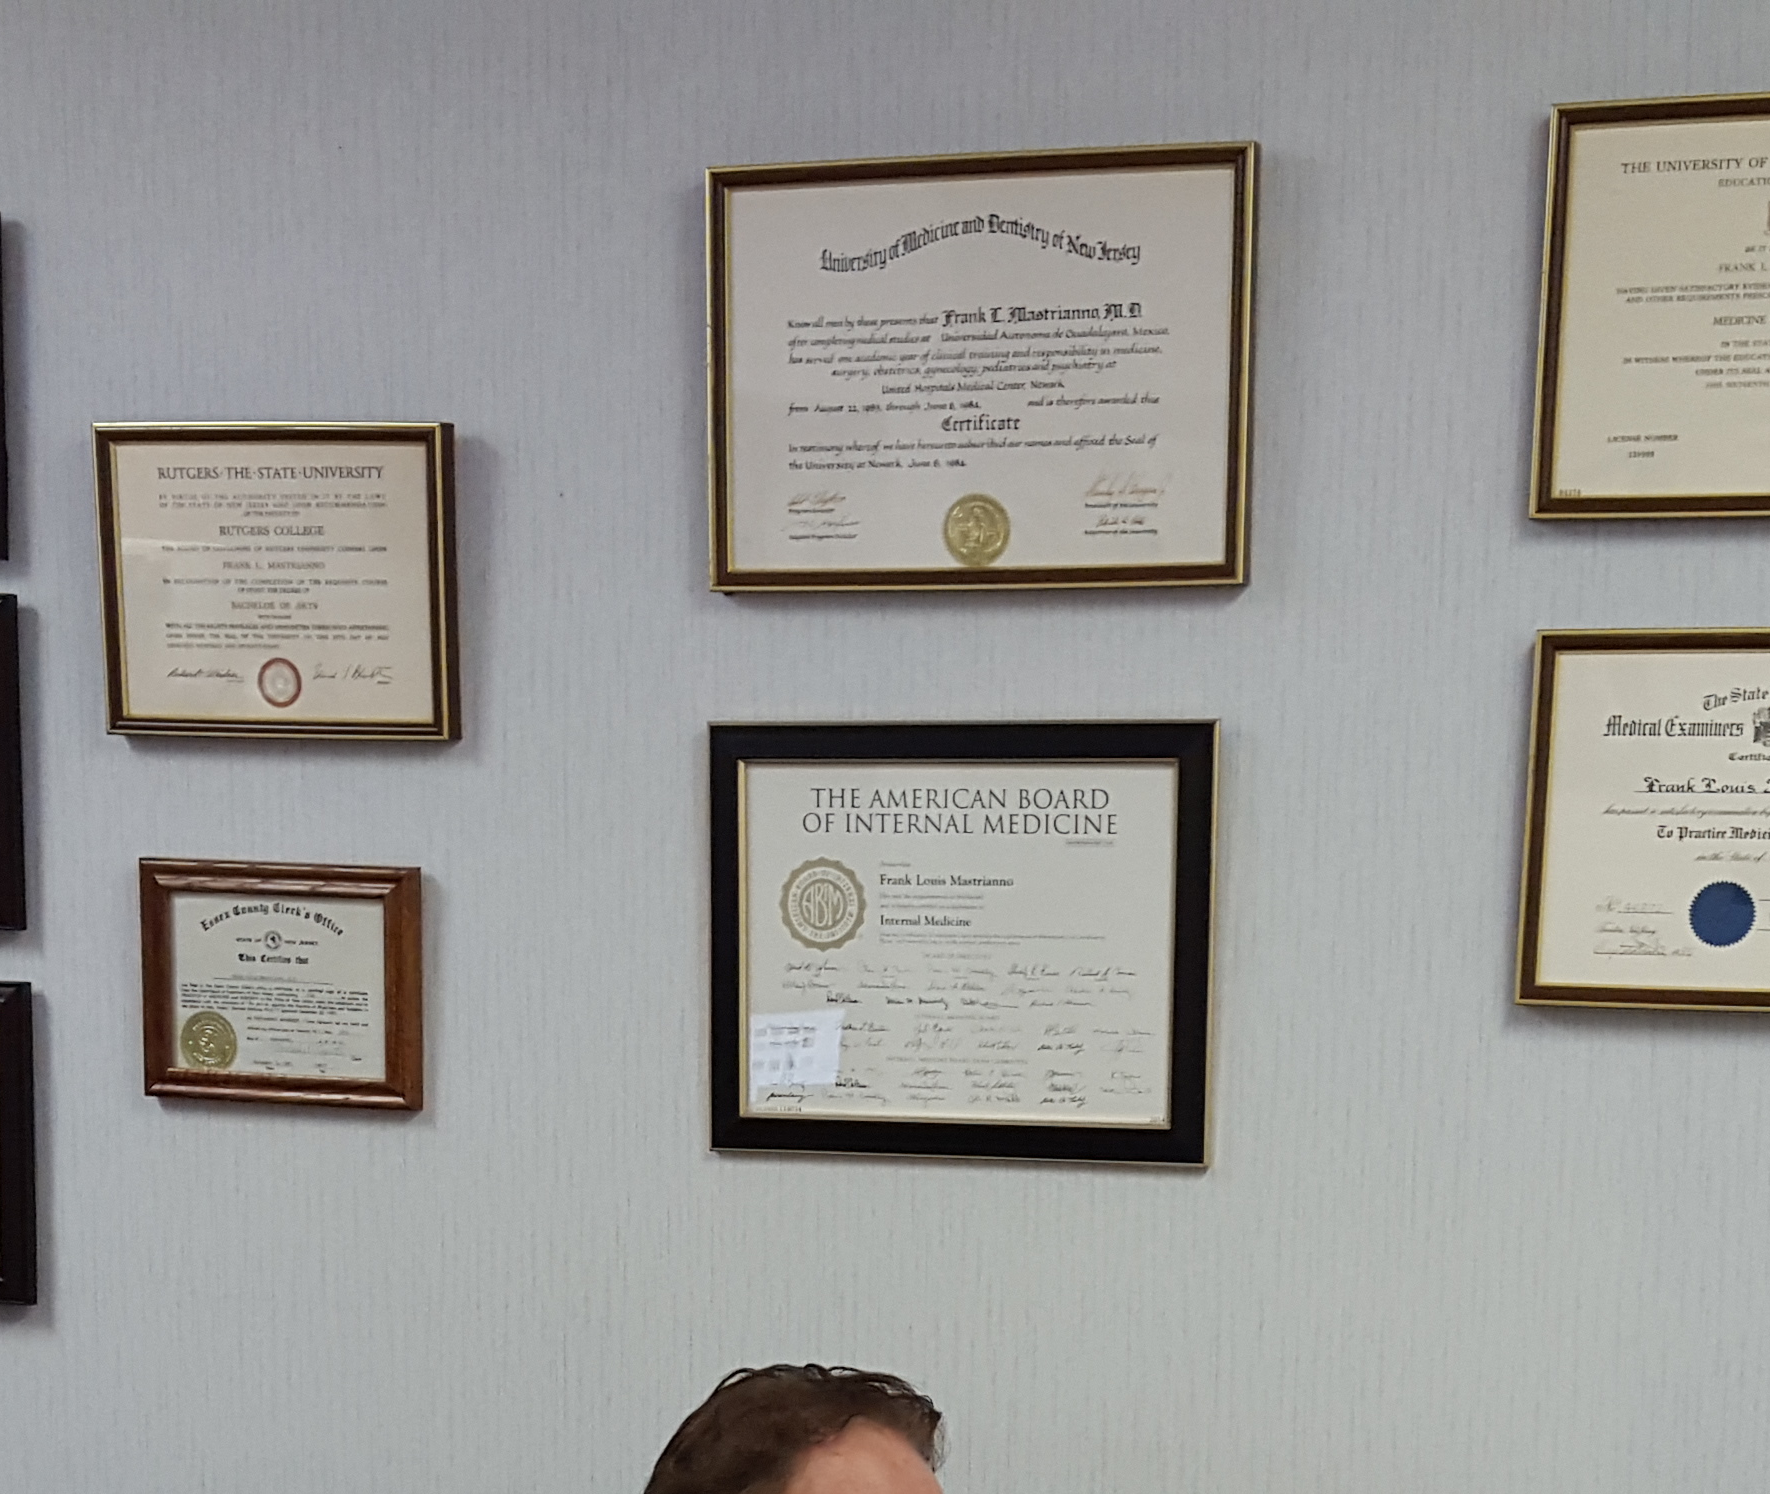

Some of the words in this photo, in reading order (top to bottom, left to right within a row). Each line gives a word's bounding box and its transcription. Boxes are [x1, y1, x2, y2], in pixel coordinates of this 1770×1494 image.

[1621, 162, 1651, 174] THE
[1656, 158, 1742, 172] UNIVERSITY
[1748, 157, 1768, 168] OF
[961, 215, 984, 234] and
[1052, 229, 1065, 250] of
[1066, 235, 1096, 260] New
[941, 306, 986, 327] Frank
[941, 413, 1020, 432] Certificate
[157, 467, 219, 480] RUTGERS
[227, 467, 252, 479] THE
[257, 467, 297, 479] STATE
[303, 466, 383, 479] UNIVERSITY
[1703, 694, 1727, 711] The
[1730, 687, 1769, 703] State
[1603, 715, 1662, 737] Medical
[1665, 716, 1744, 737] Examiners
[1643, 776, 1695, 793] Frank
[1701, 777, 1756, 793] Louis
[810, 788, 860, 809] THE
[868, 788, 1006, 809] AMERICAN
[1019, 788, 1109, 809] BOARD
[802, 812, 835, 833] OF
[845, 813, 973, 834] INTERNAL
[983, 813, 1117, 834] MEDICINE
[1657, 825, 1673, 839] To
[1677, 826, 1727, 842] Practice
[880, 873, 912, 886] Frank
[916, 874, 946, 886] Louis
[950, 875, 1014, 886] Mastrianno
[232, 904, 269, 916] County
[880, 915, 920, 926] Internal
[924, 915, 971, 927] Medicine
